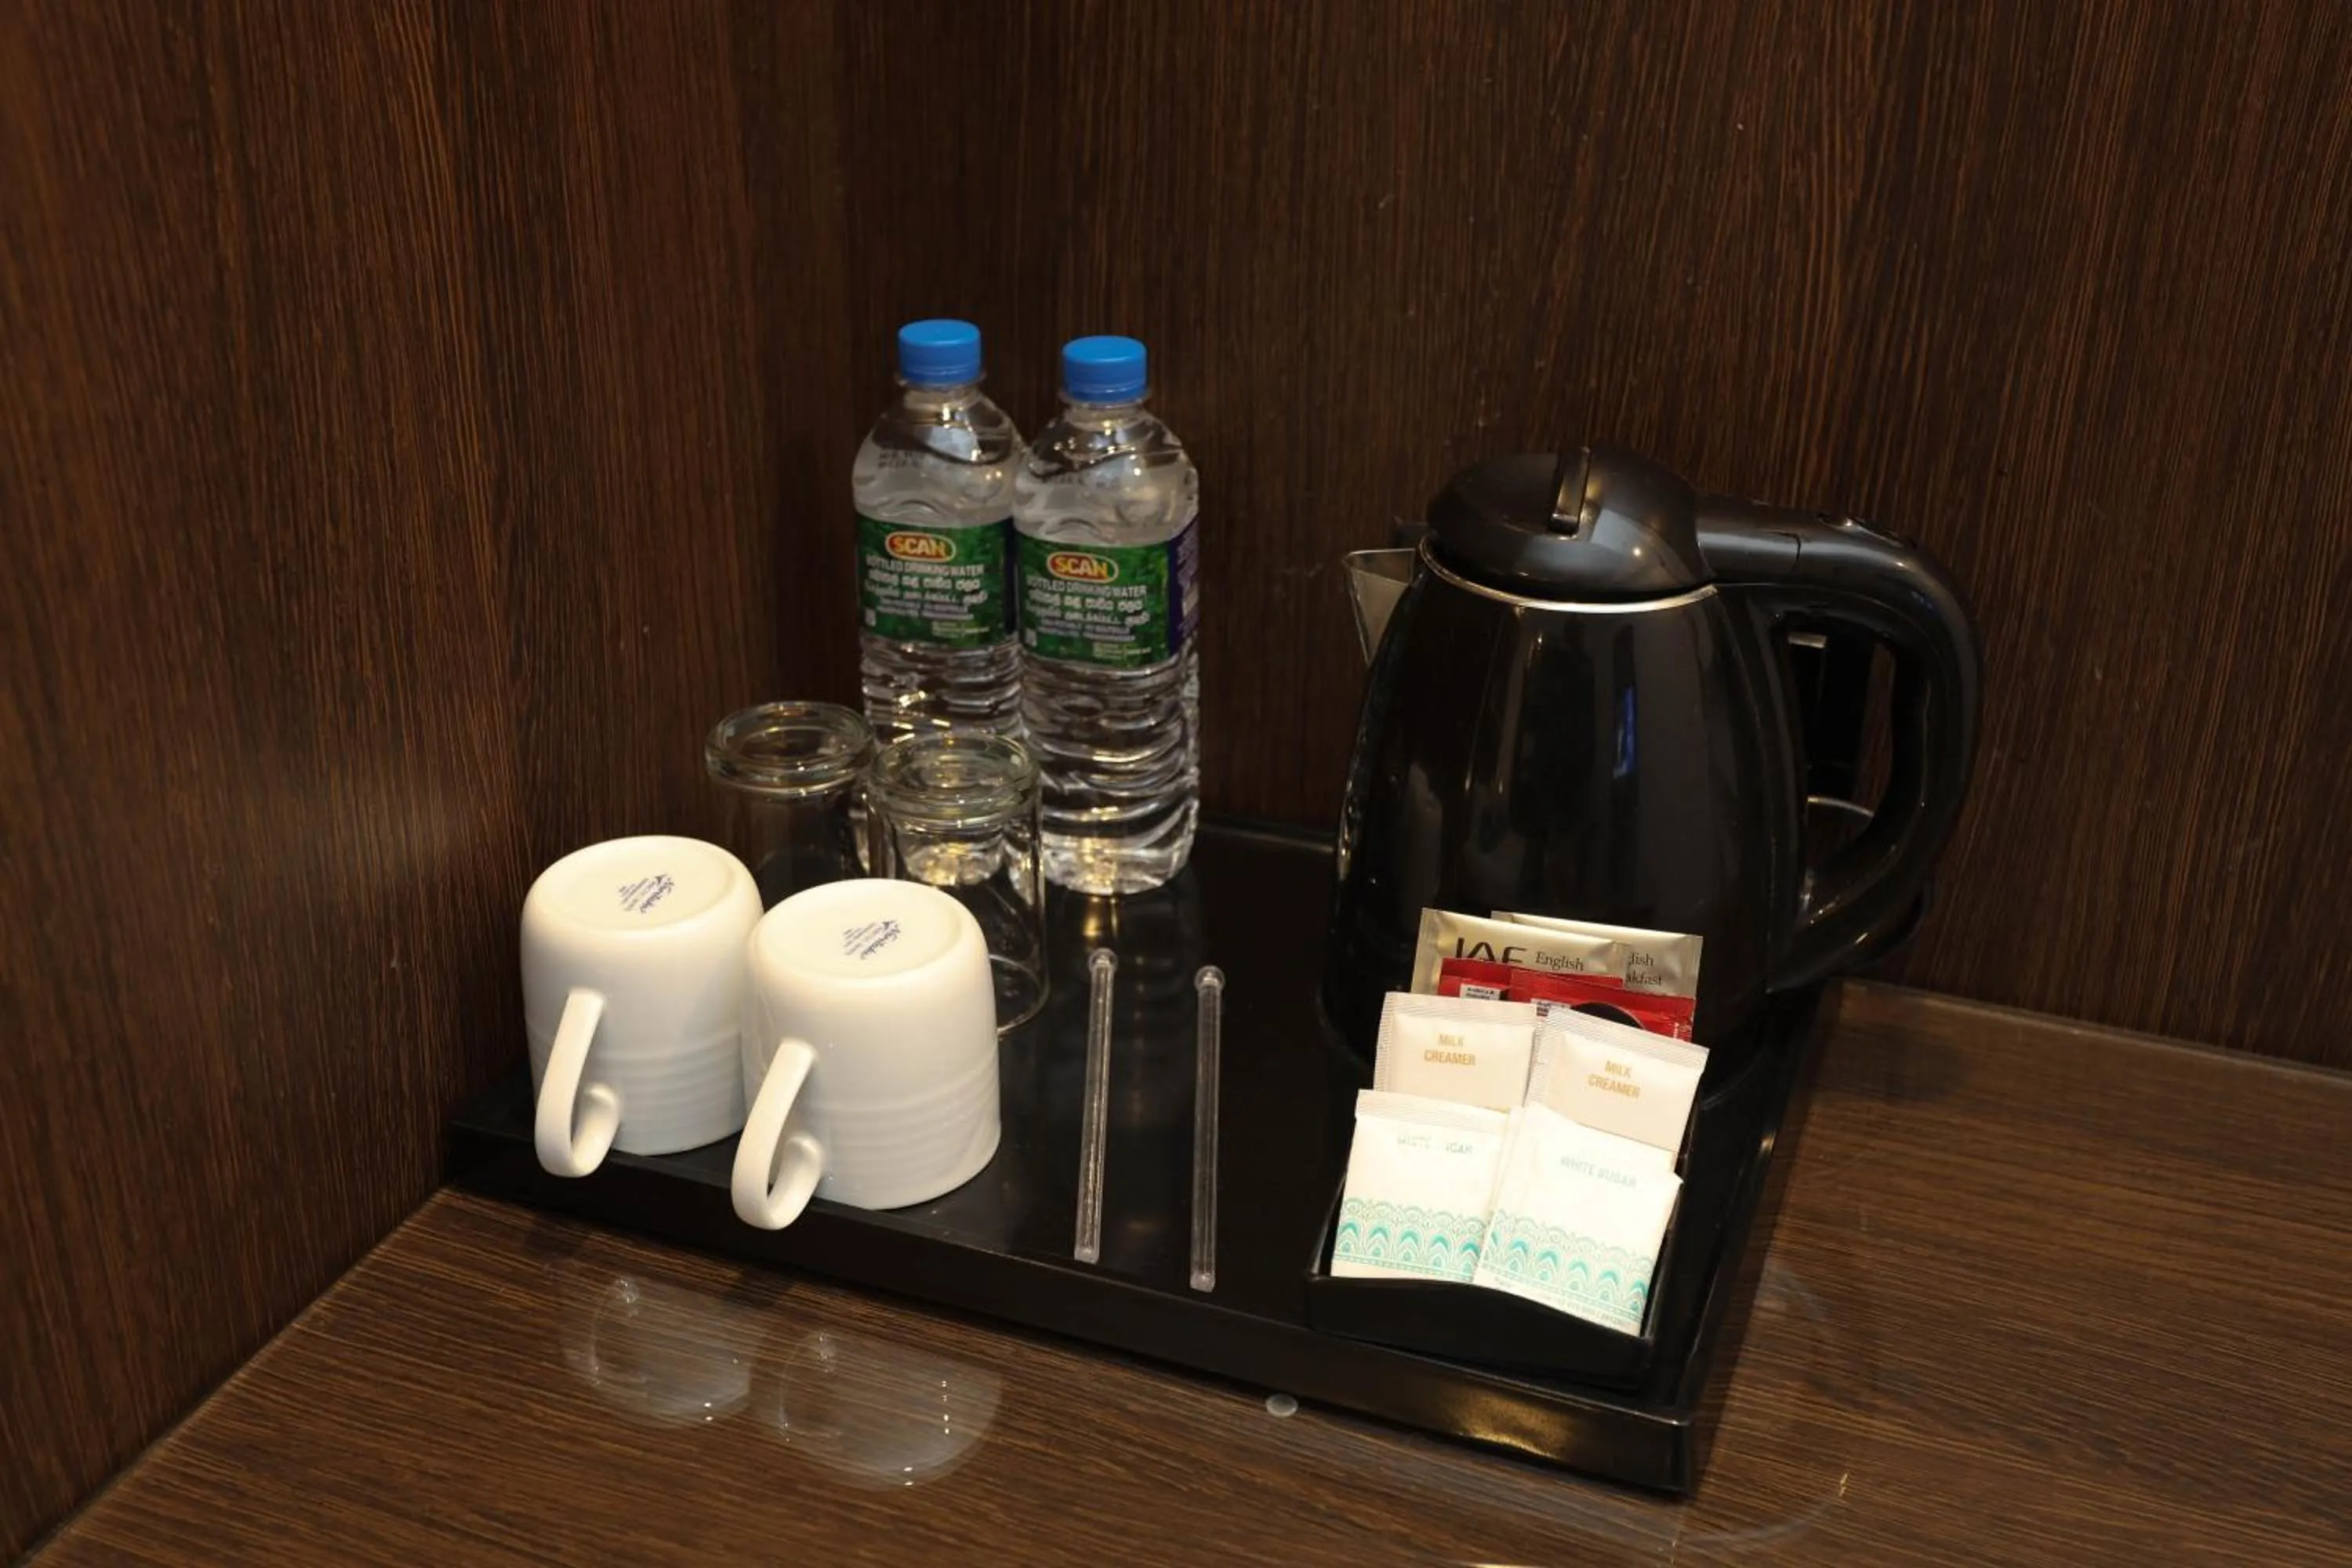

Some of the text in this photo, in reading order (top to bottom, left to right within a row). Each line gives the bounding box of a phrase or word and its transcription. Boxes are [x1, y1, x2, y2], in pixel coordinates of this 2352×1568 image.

[892, 536, 946, 557] SCAN
[1054, 557, 1109, 579] SCAN
[1534, 951, 1584, 971] English
[1437, 1033, 1465, 1047] MILK
[1424, 1048, 1476, 1066] CREAMER
[1605, 1060, 1632, 1079] MILK
[1587, 1073, 1641, 1098] CREAMER
[1559, 1155, 1638, 1189] WHITE SUGAR
